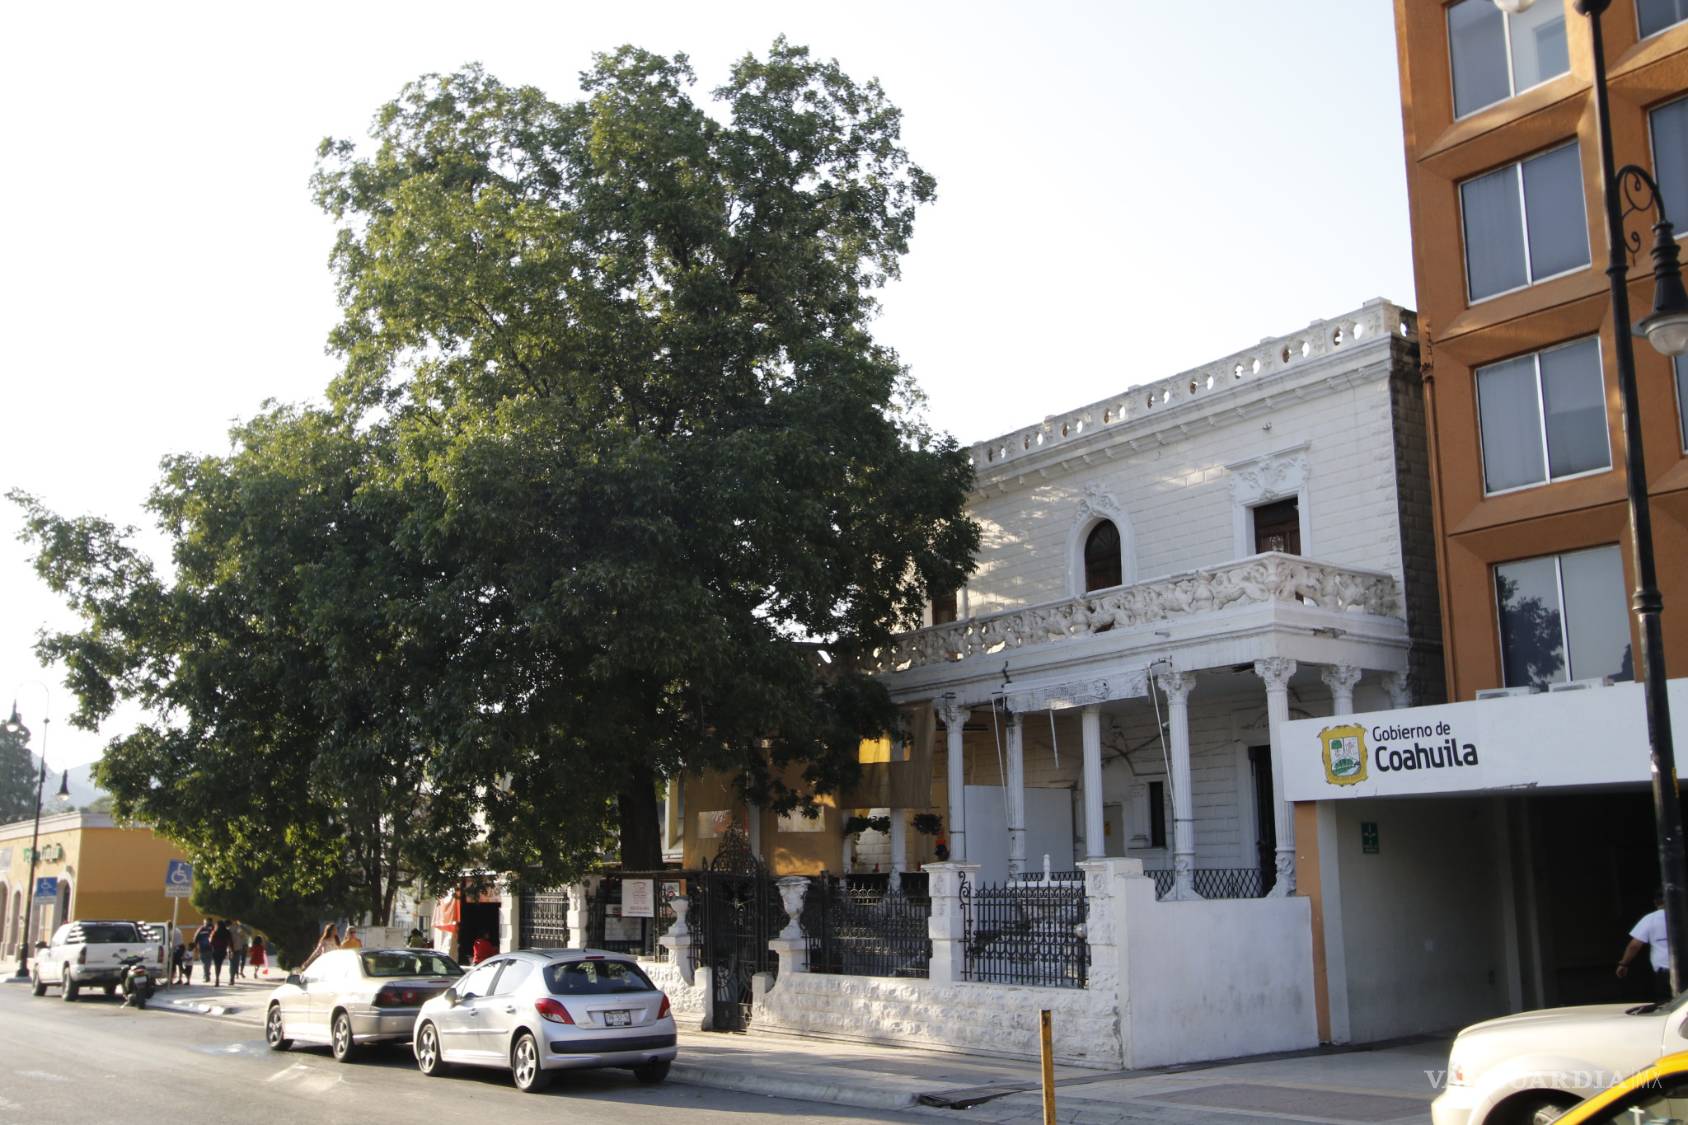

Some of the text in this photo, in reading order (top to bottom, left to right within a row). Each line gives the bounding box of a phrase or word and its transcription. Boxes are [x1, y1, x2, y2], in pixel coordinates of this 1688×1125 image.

[1372, 720, 1451, 742] Gobierno de
[1375, 738, 1479, 772] Coahuila
